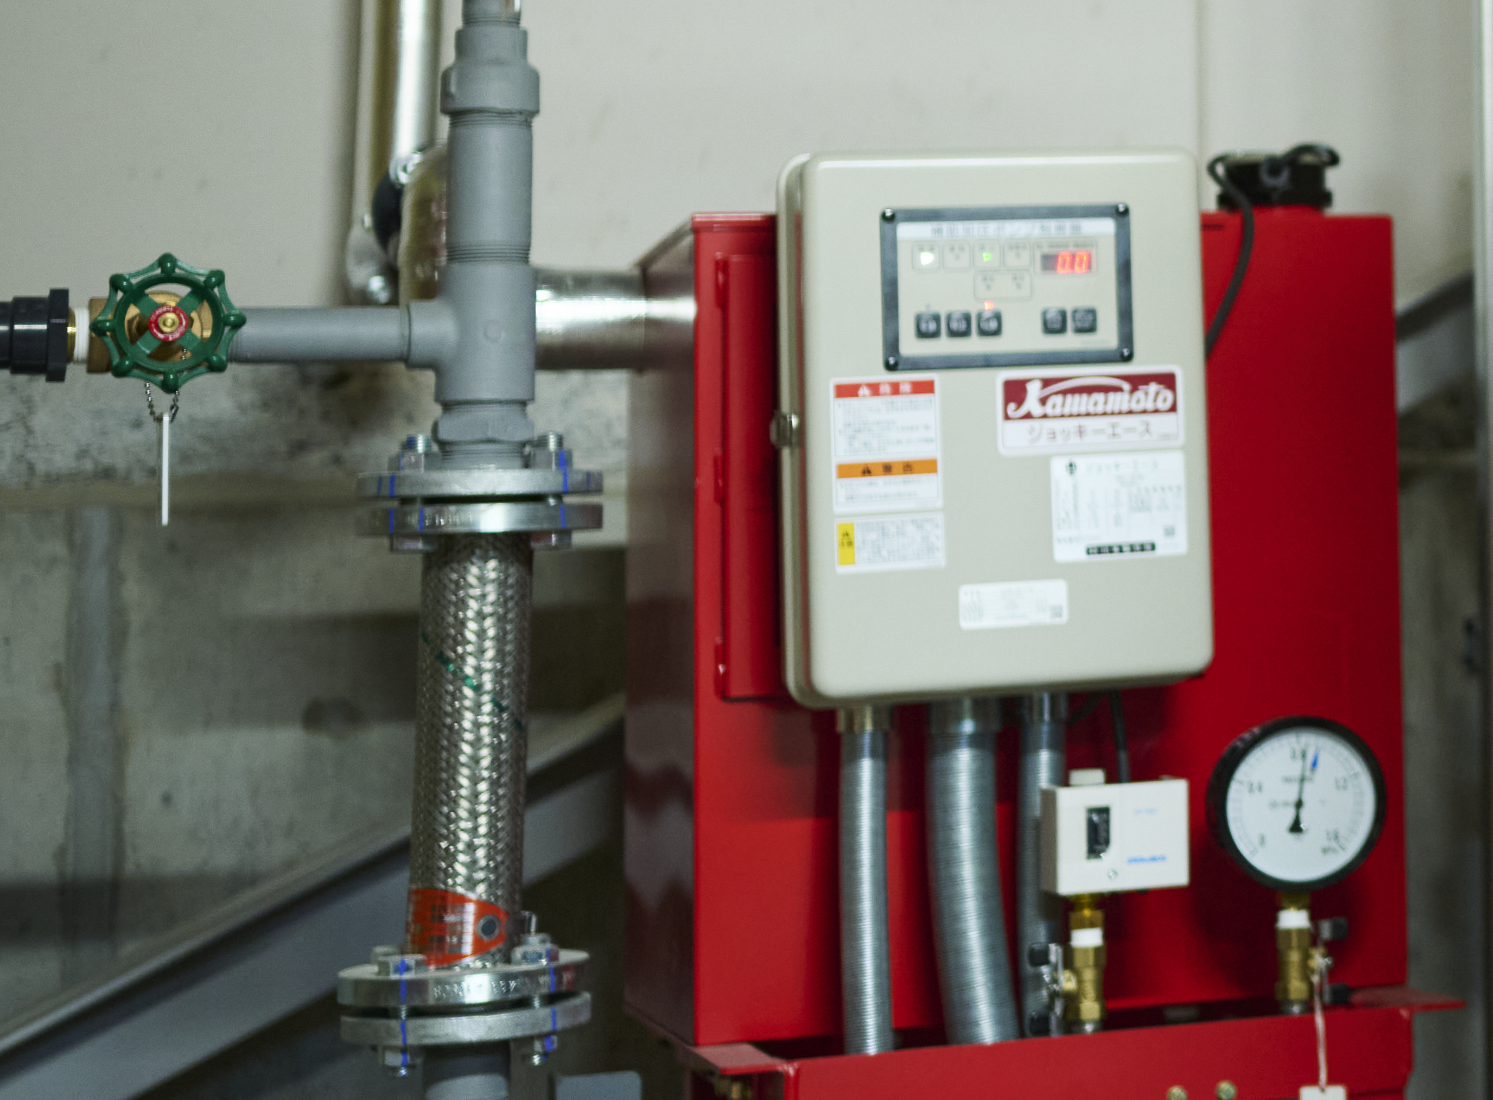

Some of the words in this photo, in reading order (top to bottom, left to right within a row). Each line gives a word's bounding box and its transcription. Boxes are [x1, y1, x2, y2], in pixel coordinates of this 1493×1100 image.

[1007, 375, 1174, 419] Kawamoto
[1027, 421, 1152, 444] ジョッキーエース
